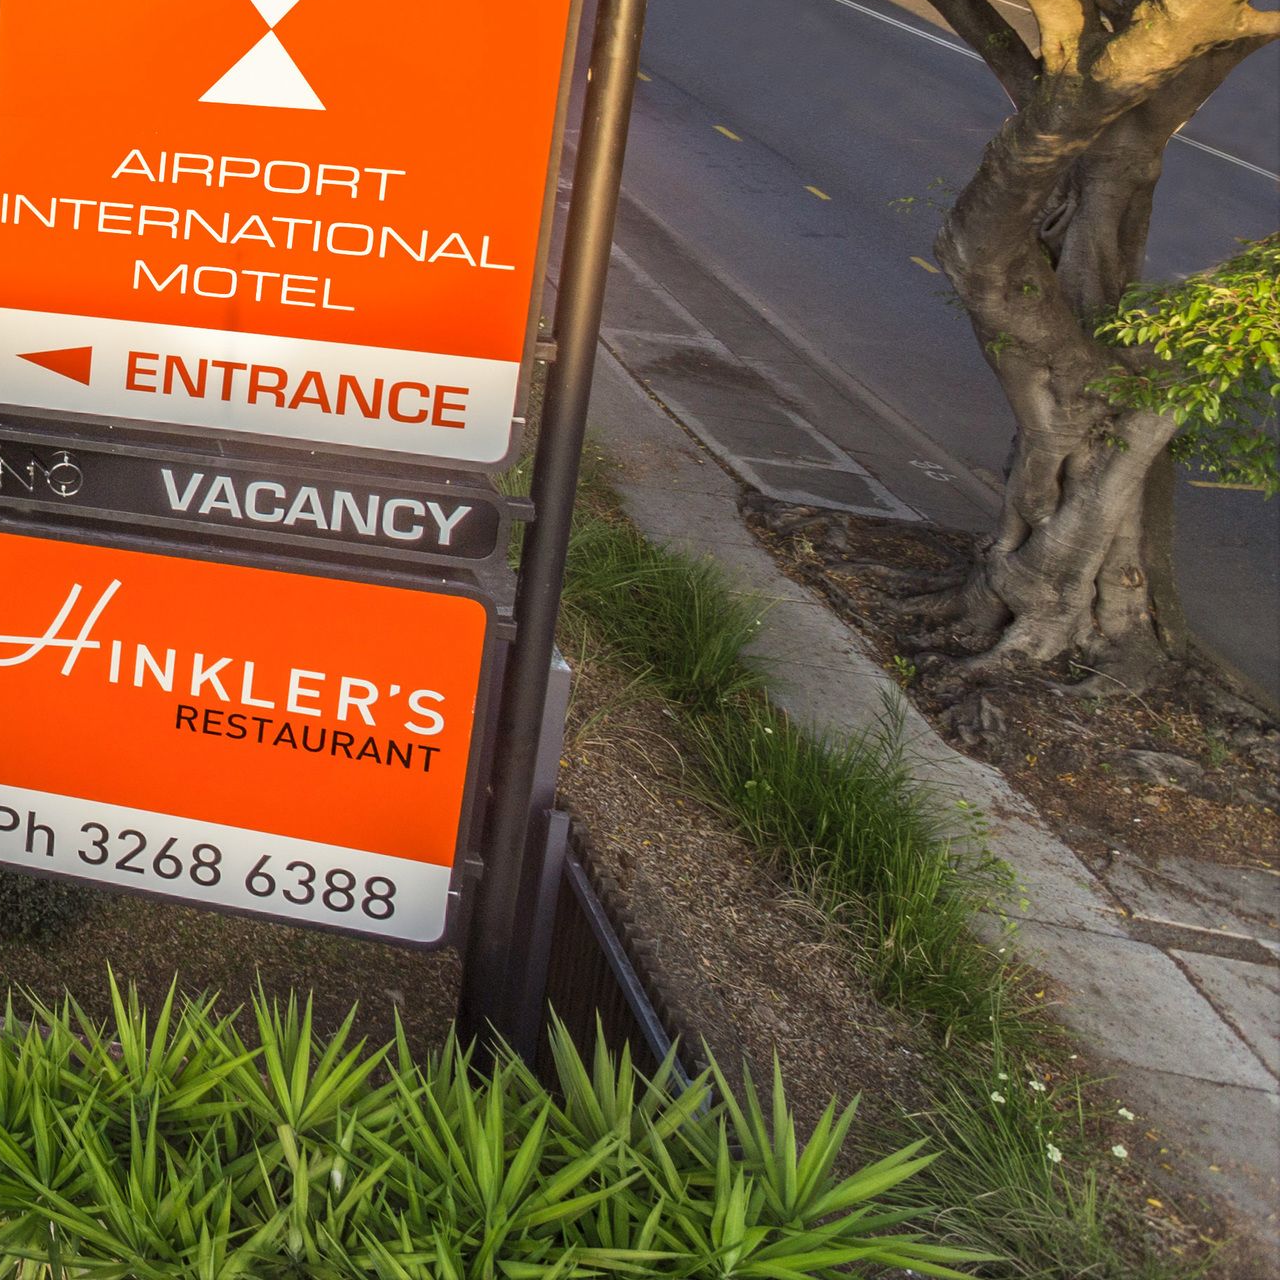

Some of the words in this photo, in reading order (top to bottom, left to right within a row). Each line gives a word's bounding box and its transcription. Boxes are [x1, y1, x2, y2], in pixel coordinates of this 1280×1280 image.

[111, 148, 407, 202] AIRPORT
[1, 192, 515, 271] INTERNATIONAL
[132, 259, 355, 312] MOTEL
[125, 350, 470, 429] ENTRANCE
[160, 468, 473, 546] VACANCY
[175, 704, 441, 773] RESTAURANT
[77, 821, 223, 888] 3268
[244, 854, 397, 921] 6388
